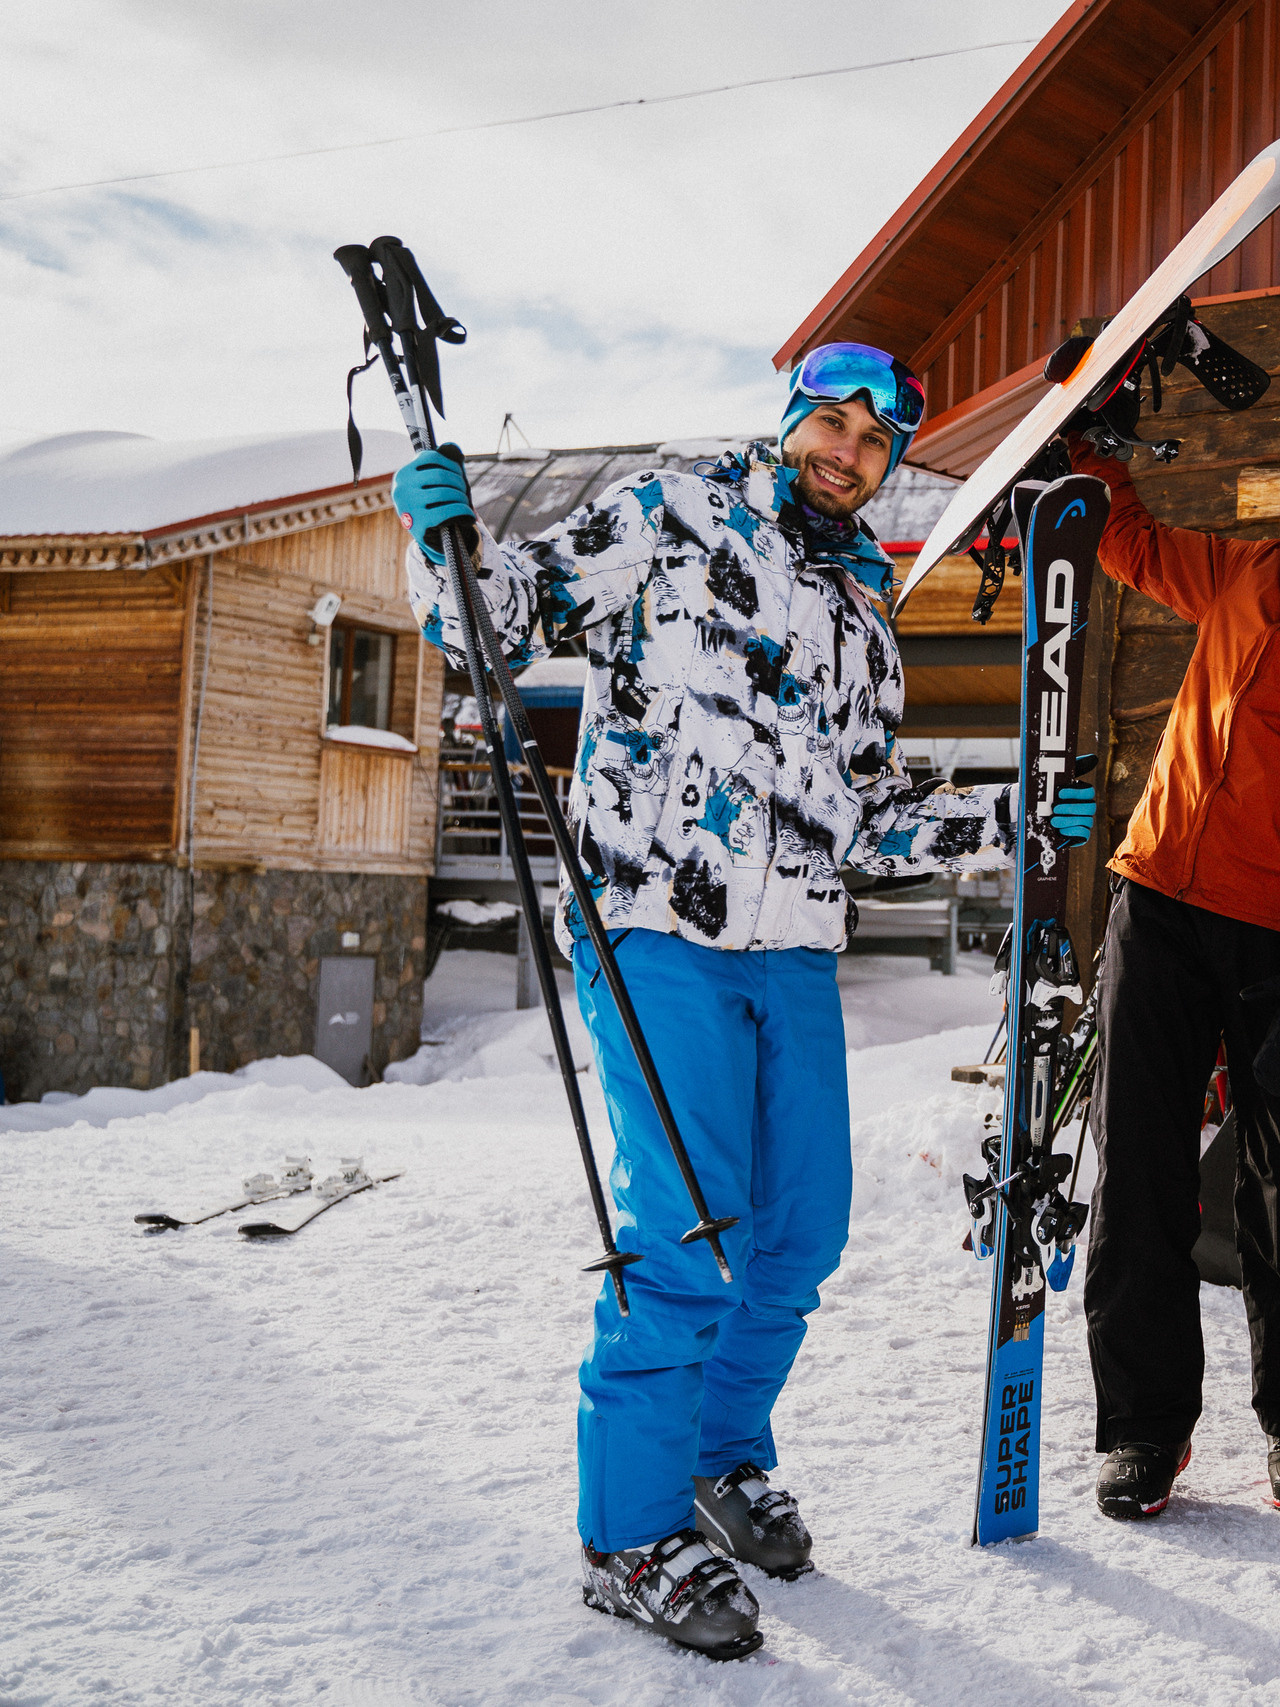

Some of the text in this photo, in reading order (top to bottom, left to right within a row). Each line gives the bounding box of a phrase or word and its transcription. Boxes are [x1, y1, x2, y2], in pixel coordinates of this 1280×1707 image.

[1036, 558, 1075, 817] HEAD
[994, 1383, 1019, 1516] SUPER
[1010, 1379, 1034, 1511] SHAPE
